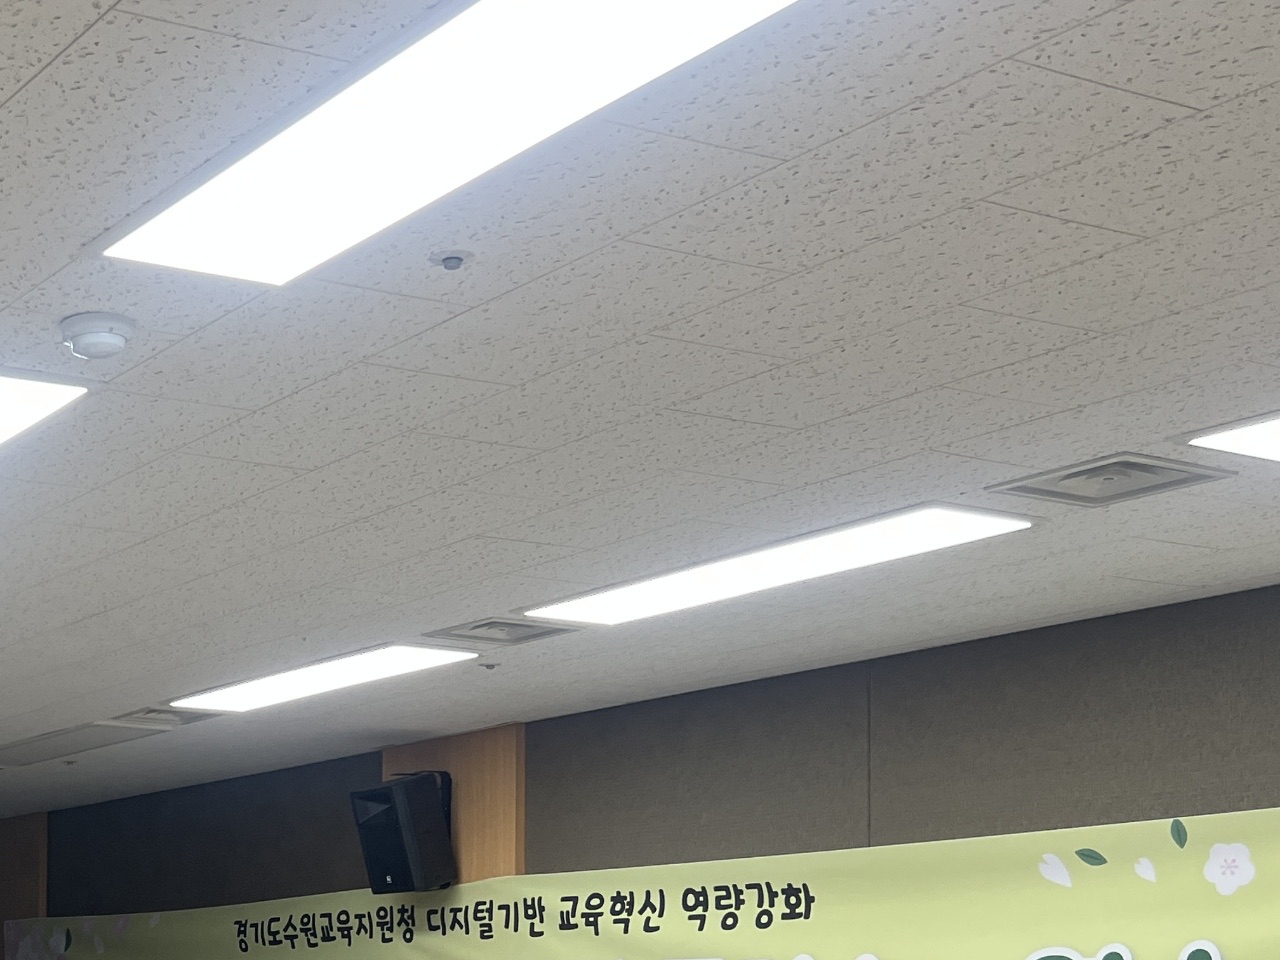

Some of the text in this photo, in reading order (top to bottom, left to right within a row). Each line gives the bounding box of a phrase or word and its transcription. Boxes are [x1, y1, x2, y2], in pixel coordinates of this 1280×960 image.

[233, 881, 815, 952] 경기도수원교육지원청 디지털기반 교육혁신 역량강화
